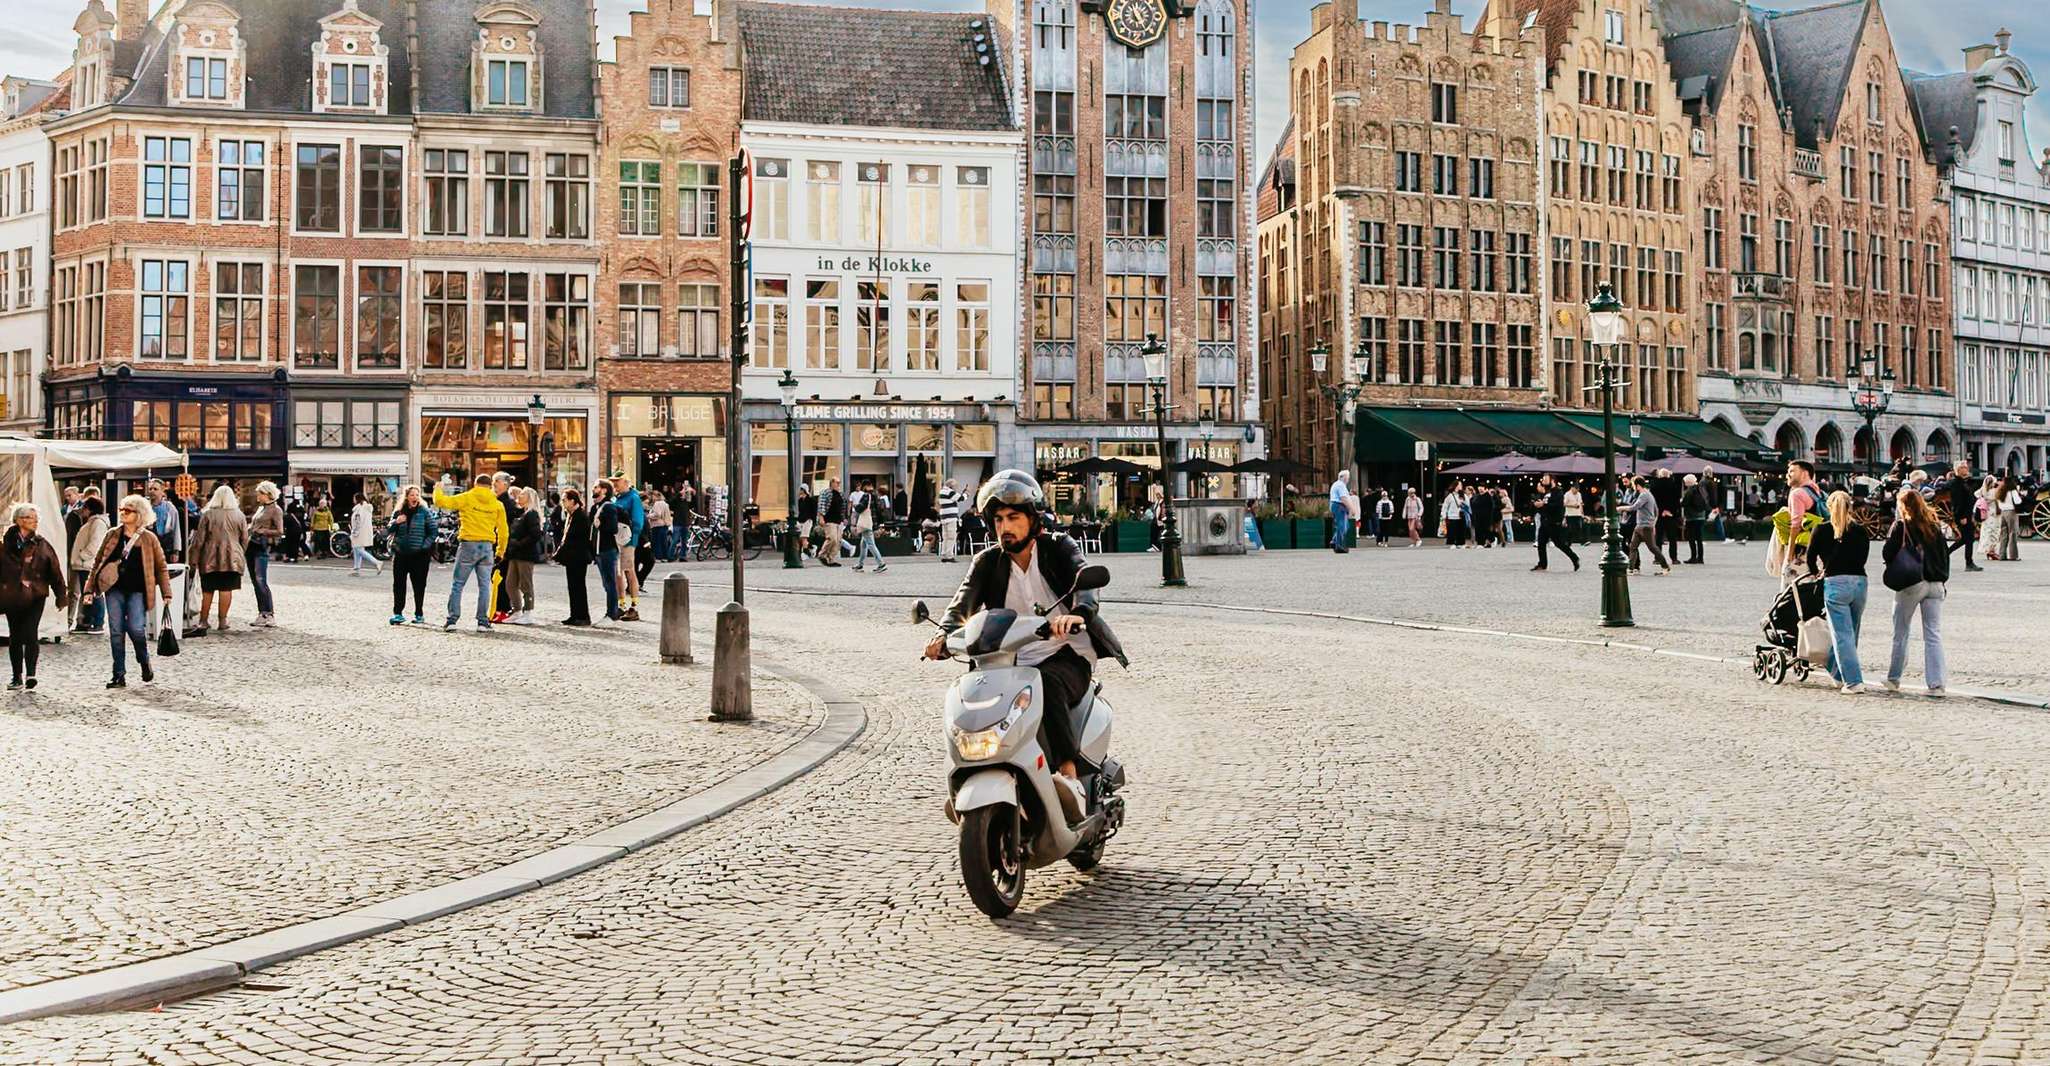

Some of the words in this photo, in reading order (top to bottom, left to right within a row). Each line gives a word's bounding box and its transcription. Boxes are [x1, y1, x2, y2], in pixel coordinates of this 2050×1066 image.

[818, 256, 834, 270] in
[841, 257, 861, 270] de
[867, 257, 931, 272] Klokke
[648, 405, 712, 420] BRUGGE
[793, 406, 831, 419] FLAME
[834, 406, 887, 420] GRILLING
[890, 407, 922, 419] SINCE
[926, 407, 956, 419] 1954
